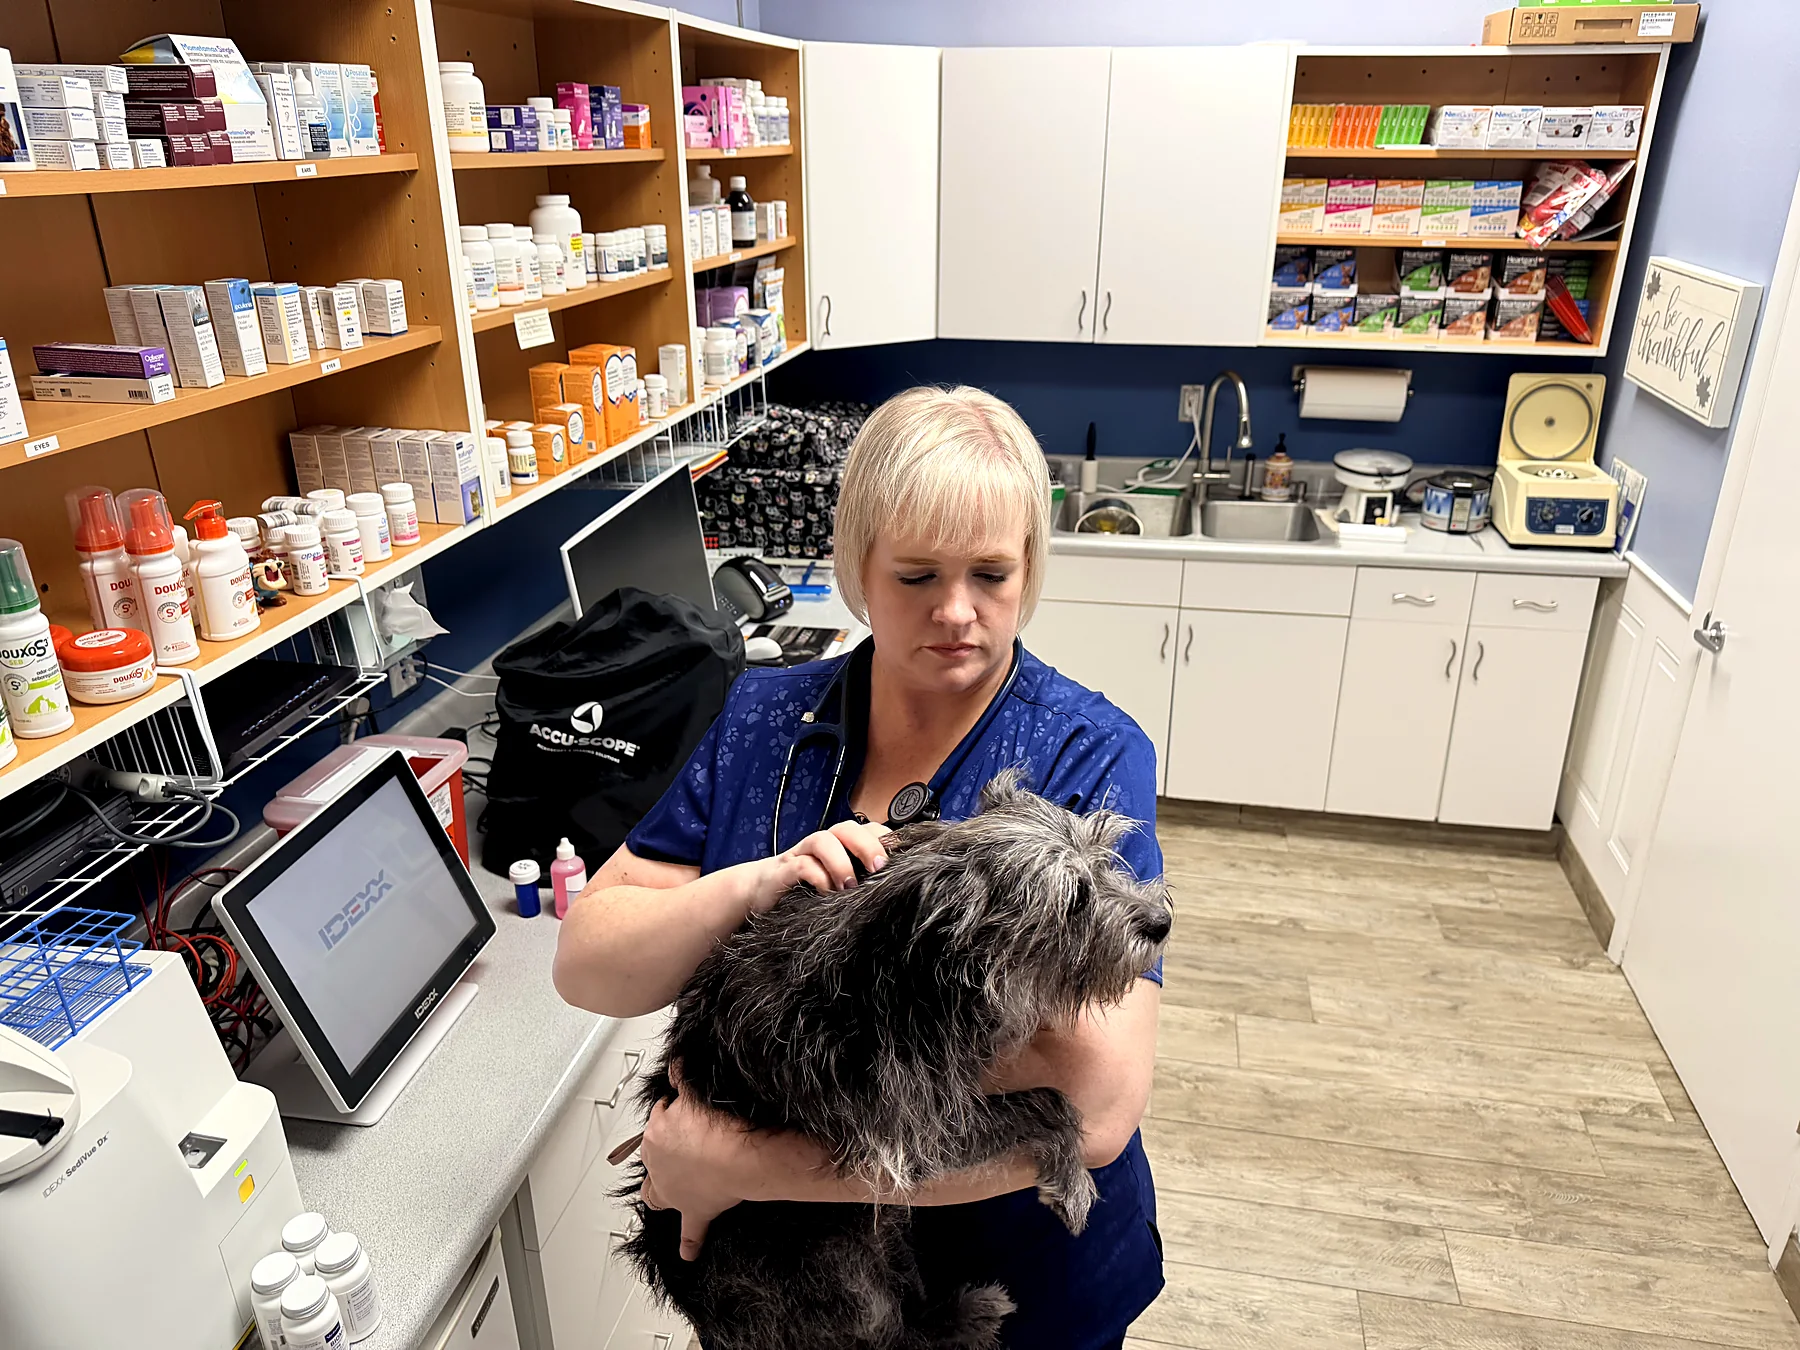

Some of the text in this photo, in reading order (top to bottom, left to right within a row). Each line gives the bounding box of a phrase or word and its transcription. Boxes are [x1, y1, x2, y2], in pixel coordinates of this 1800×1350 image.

[1664, 285, 1682, 330] be
[1638, 311, 1725, 381] thankful
[34, 441, 50, 452] EYES
[318, 869, 394, 951] IDEXX
[414, 988, 438, 1020] IDEXX
[42, 1135, 108, 1198] IDEXX SediVue Dx
